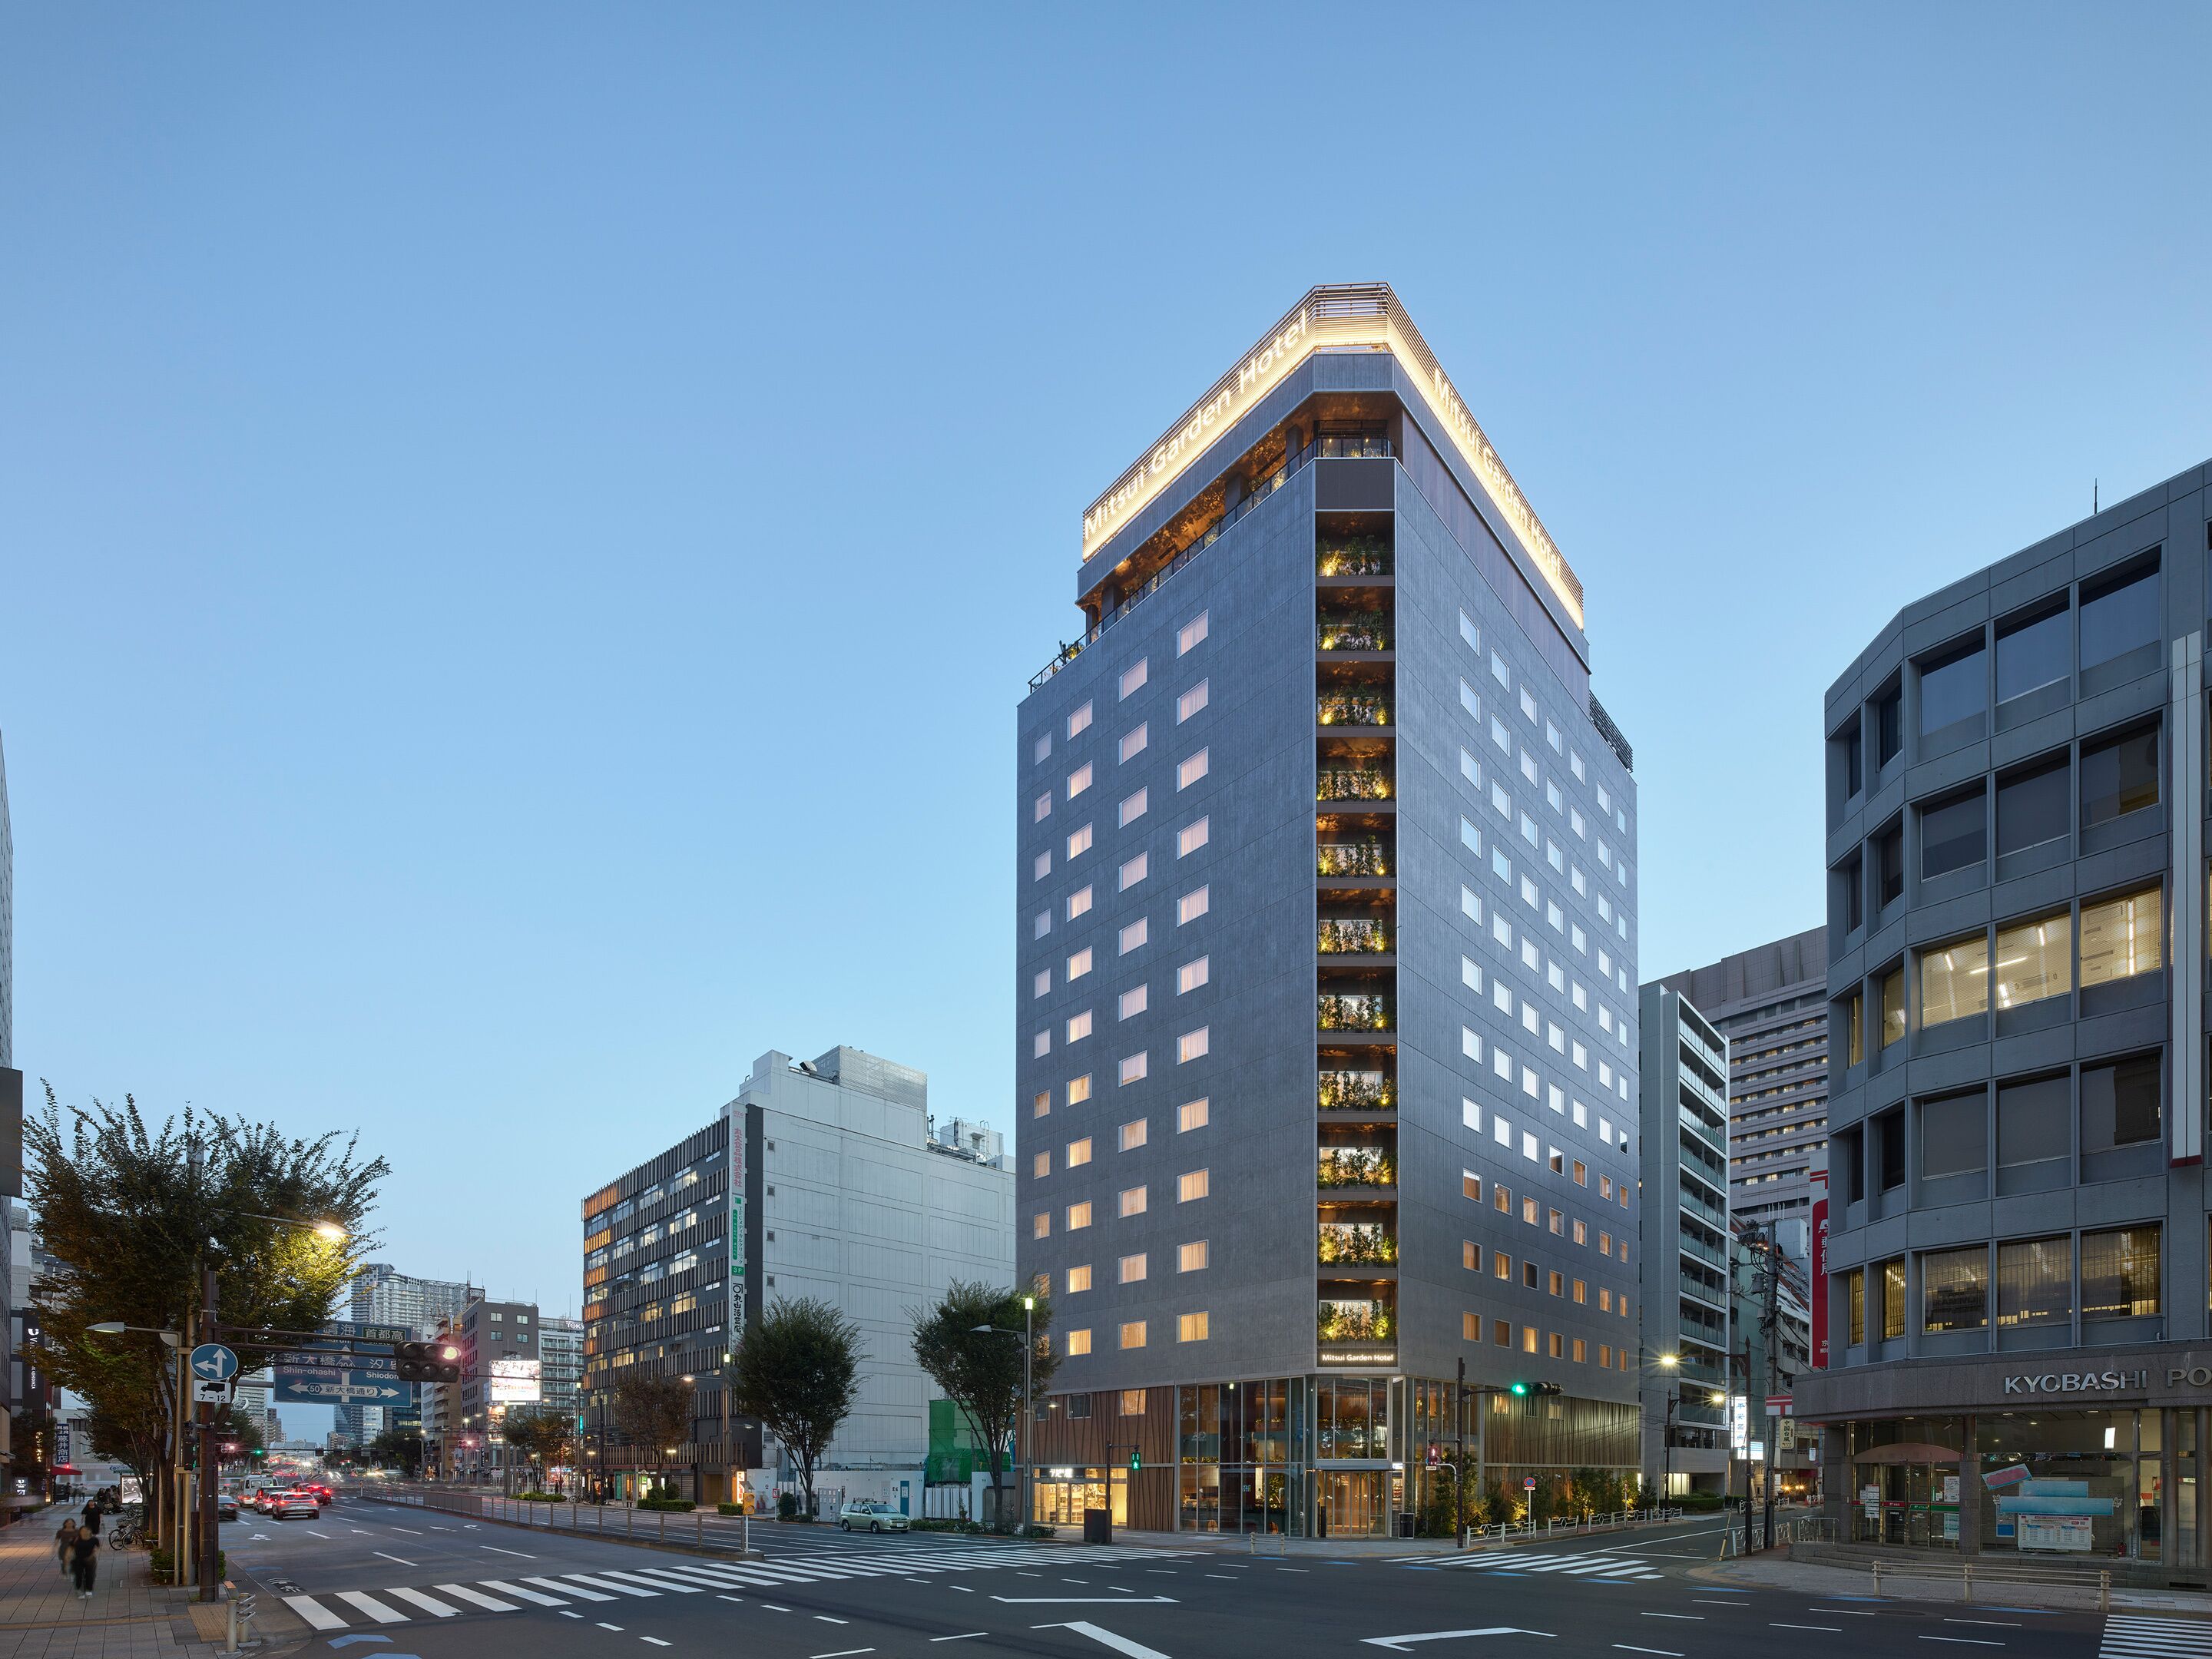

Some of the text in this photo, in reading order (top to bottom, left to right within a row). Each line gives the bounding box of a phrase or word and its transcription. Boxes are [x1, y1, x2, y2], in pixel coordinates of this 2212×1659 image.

[1083, 307, 1308, 541] Mitsui Garden Hotel
[1433, 368, 1561, 578] Mitsui Garden Hotel
[365, 1328, 404, 1340] 首都高
[283, 1353, 335, 1367] 新大橋
[283, 1366, 336, 1376] Shin-ohashi
[2005, 1366, 2212, 1394] KYOBASHI PO
[325, 1386, 375, 1396] 新大橋通り
[58, 1435, 68, 1463] 藤井商店
